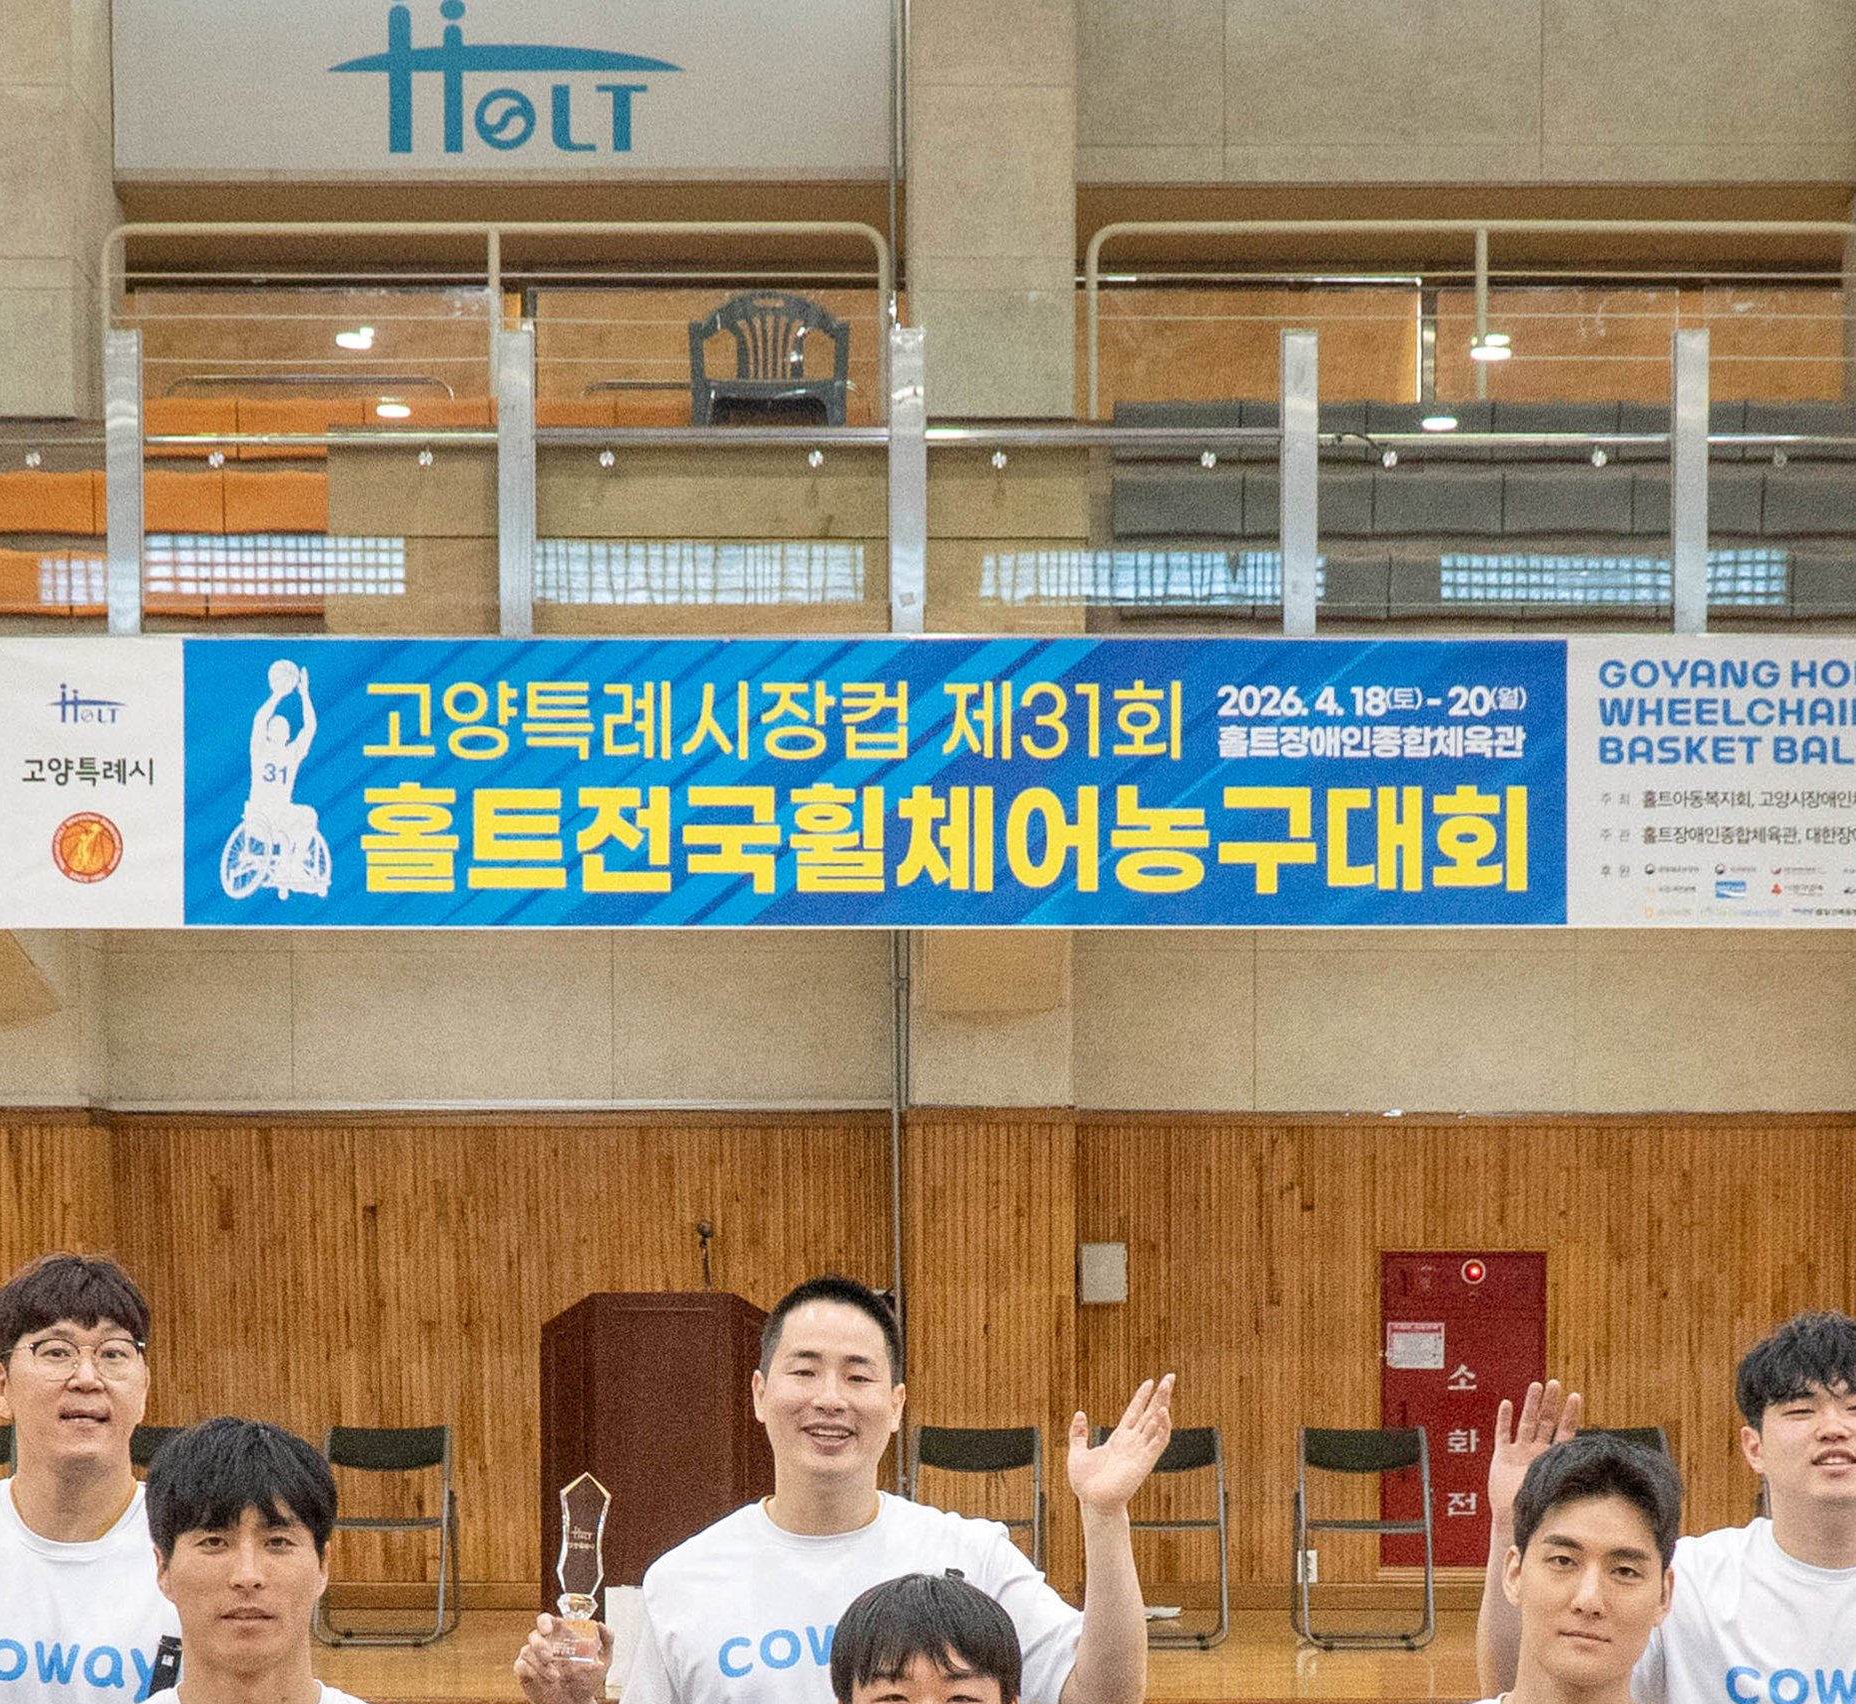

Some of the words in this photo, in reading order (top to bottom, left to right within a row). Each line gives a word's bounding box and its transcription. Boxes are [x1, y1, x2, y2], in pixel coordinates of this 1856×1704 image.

[358, 2, 665, 153] HOLT
[1598, 659, 1781, 689] GOYANG
[54, 683, 123, 723] HOLT
[1217, 685, 1309, 717] 2026.
[1314, 685, 1344, 717] 4.
[1350, 685, 1423, 717] 18(토)
[1447, 685, 1527, 717] 20(월)
[361, 681, 908, 762] 고양특례시장컵
[943, 679, 1183, 762] 제31회
[1217, 725, 1527, 758] 홀트장애인종합체육관
[1598, 735, 1762, 765] BASKET
[21, 757, 154, 786] 고양특례시
[262, 762, 289, 785] 31
[360, 784, 1529, 895] 홀트전국휠체어농구대회
